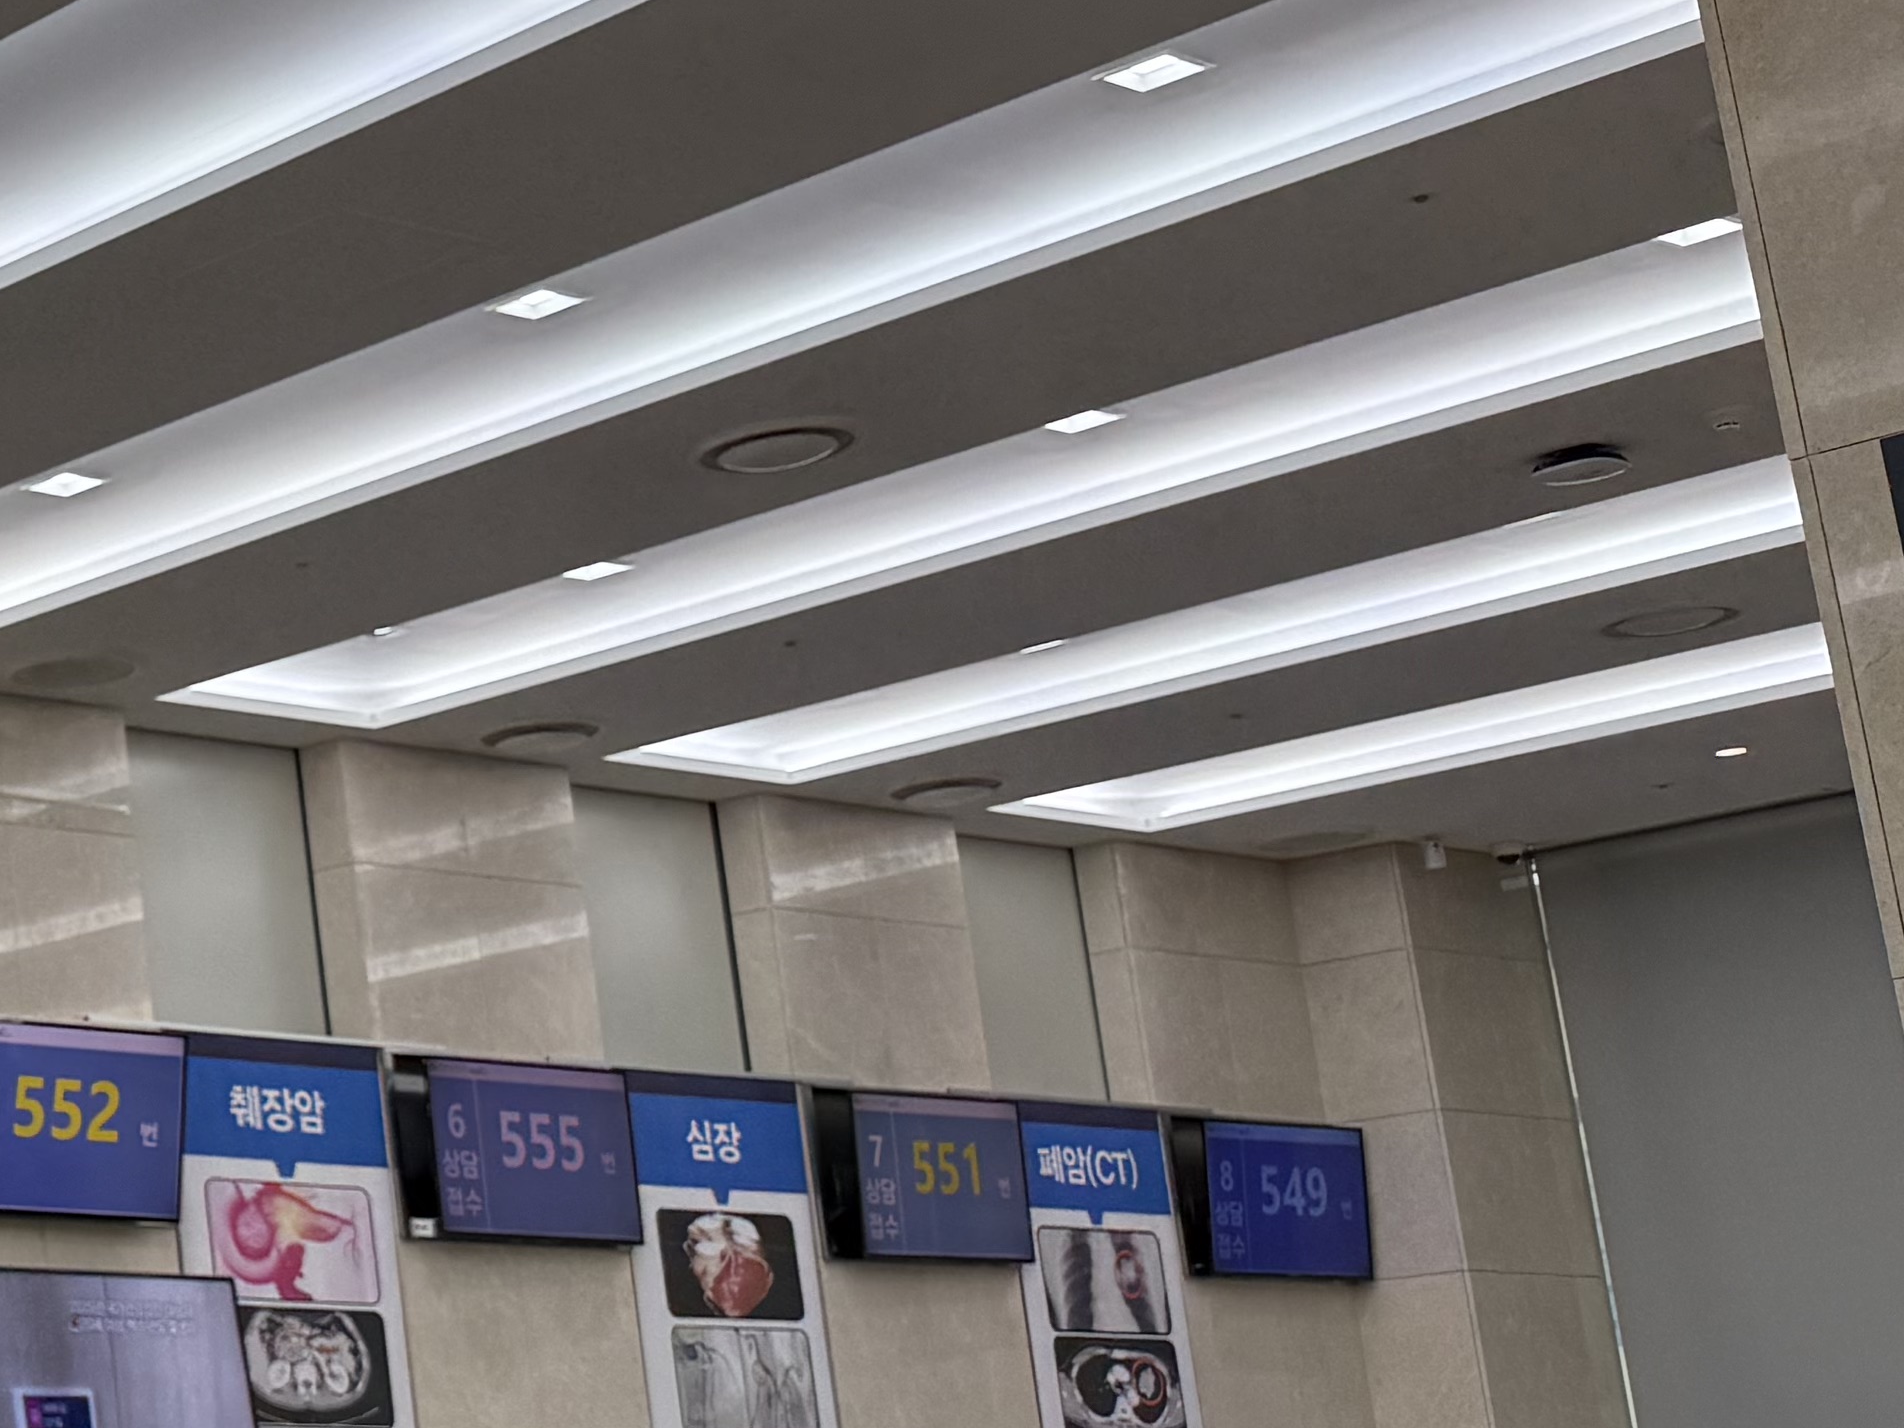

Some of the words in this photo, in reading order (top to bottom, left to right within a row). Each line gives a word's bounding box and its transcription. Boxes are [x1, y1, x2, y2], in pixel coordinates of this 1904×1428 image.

[13, 1075, 120, 1143] 552
[140, 1122, 159, 1147] 번
[229, 1084, 325, 1135] 췌장암
[448, 1103, 466, 1138] 6
[499, 1110, 584, 1172] 555
[686, 1119, 742, 1164] 심장
[868, 1135, 882, 1167] 7
[442, 1149, 479, 1180] 상담
[912, 1140, 981, 1196] 551
[1037, 1145, 1138, 1190] 폐암(CT)
[1220, 1160, 1234, 1192] 8
[446, 1188, 482, 1216] 접수
[1260, 1164, 1328, 1217] 549
